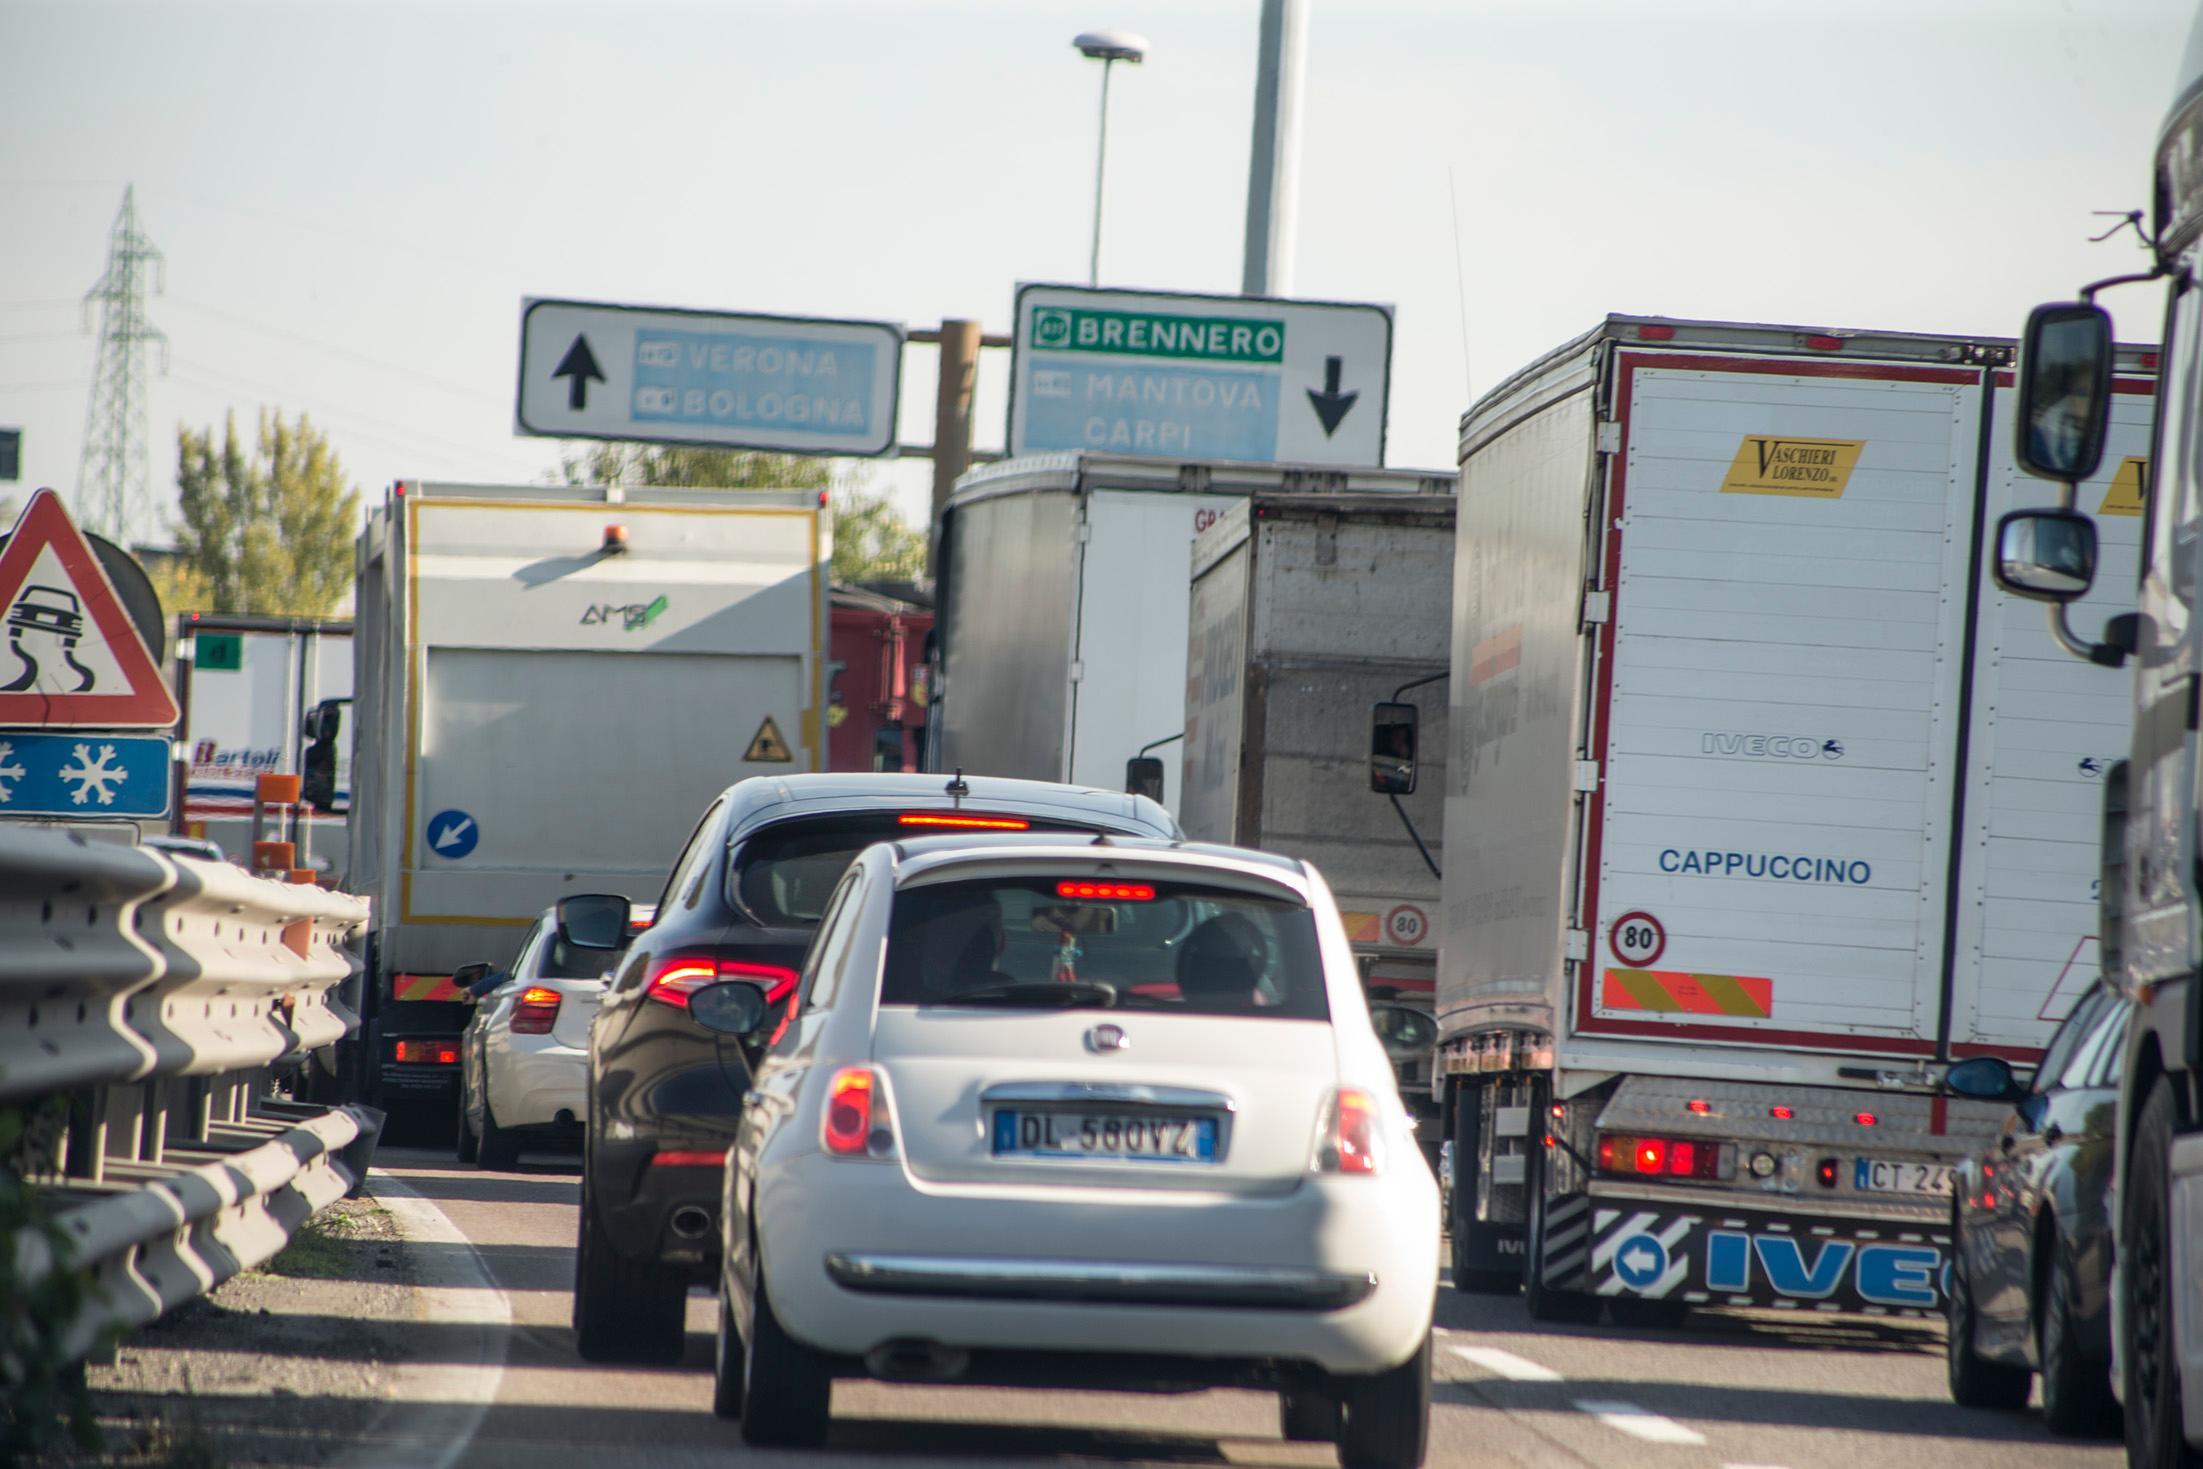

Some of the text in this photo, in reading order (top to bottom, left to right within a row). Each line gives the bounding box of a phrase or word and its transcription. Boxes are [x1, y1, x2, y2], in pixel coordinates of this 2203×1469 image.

[1077, 317, 1281, 356] BRENNERO
[687, 343, 838, 378] VERONA
[683, 387, 865, 427] BOLOGNA
[1087, 372, 1262, 409] MANTOVA
[1084, 416, 1191, 451] CARPI
[1749, 440, 1836, 479] VASCHIERI
[1772, 465, 1829, 482] LORENZO
[1702, 732, 1819, 760] IVECO
[1659, 849, 1871, 884] CAPPUCCINO
[1396, 916, 1417, 935] 80
[1624, 925, 1652, 949] 80
[1022, 1116, 1061, 1149] DL
[1873, 1163, 1903, 1190] CT
[1706, 1229, 1951, 1308] IVE
